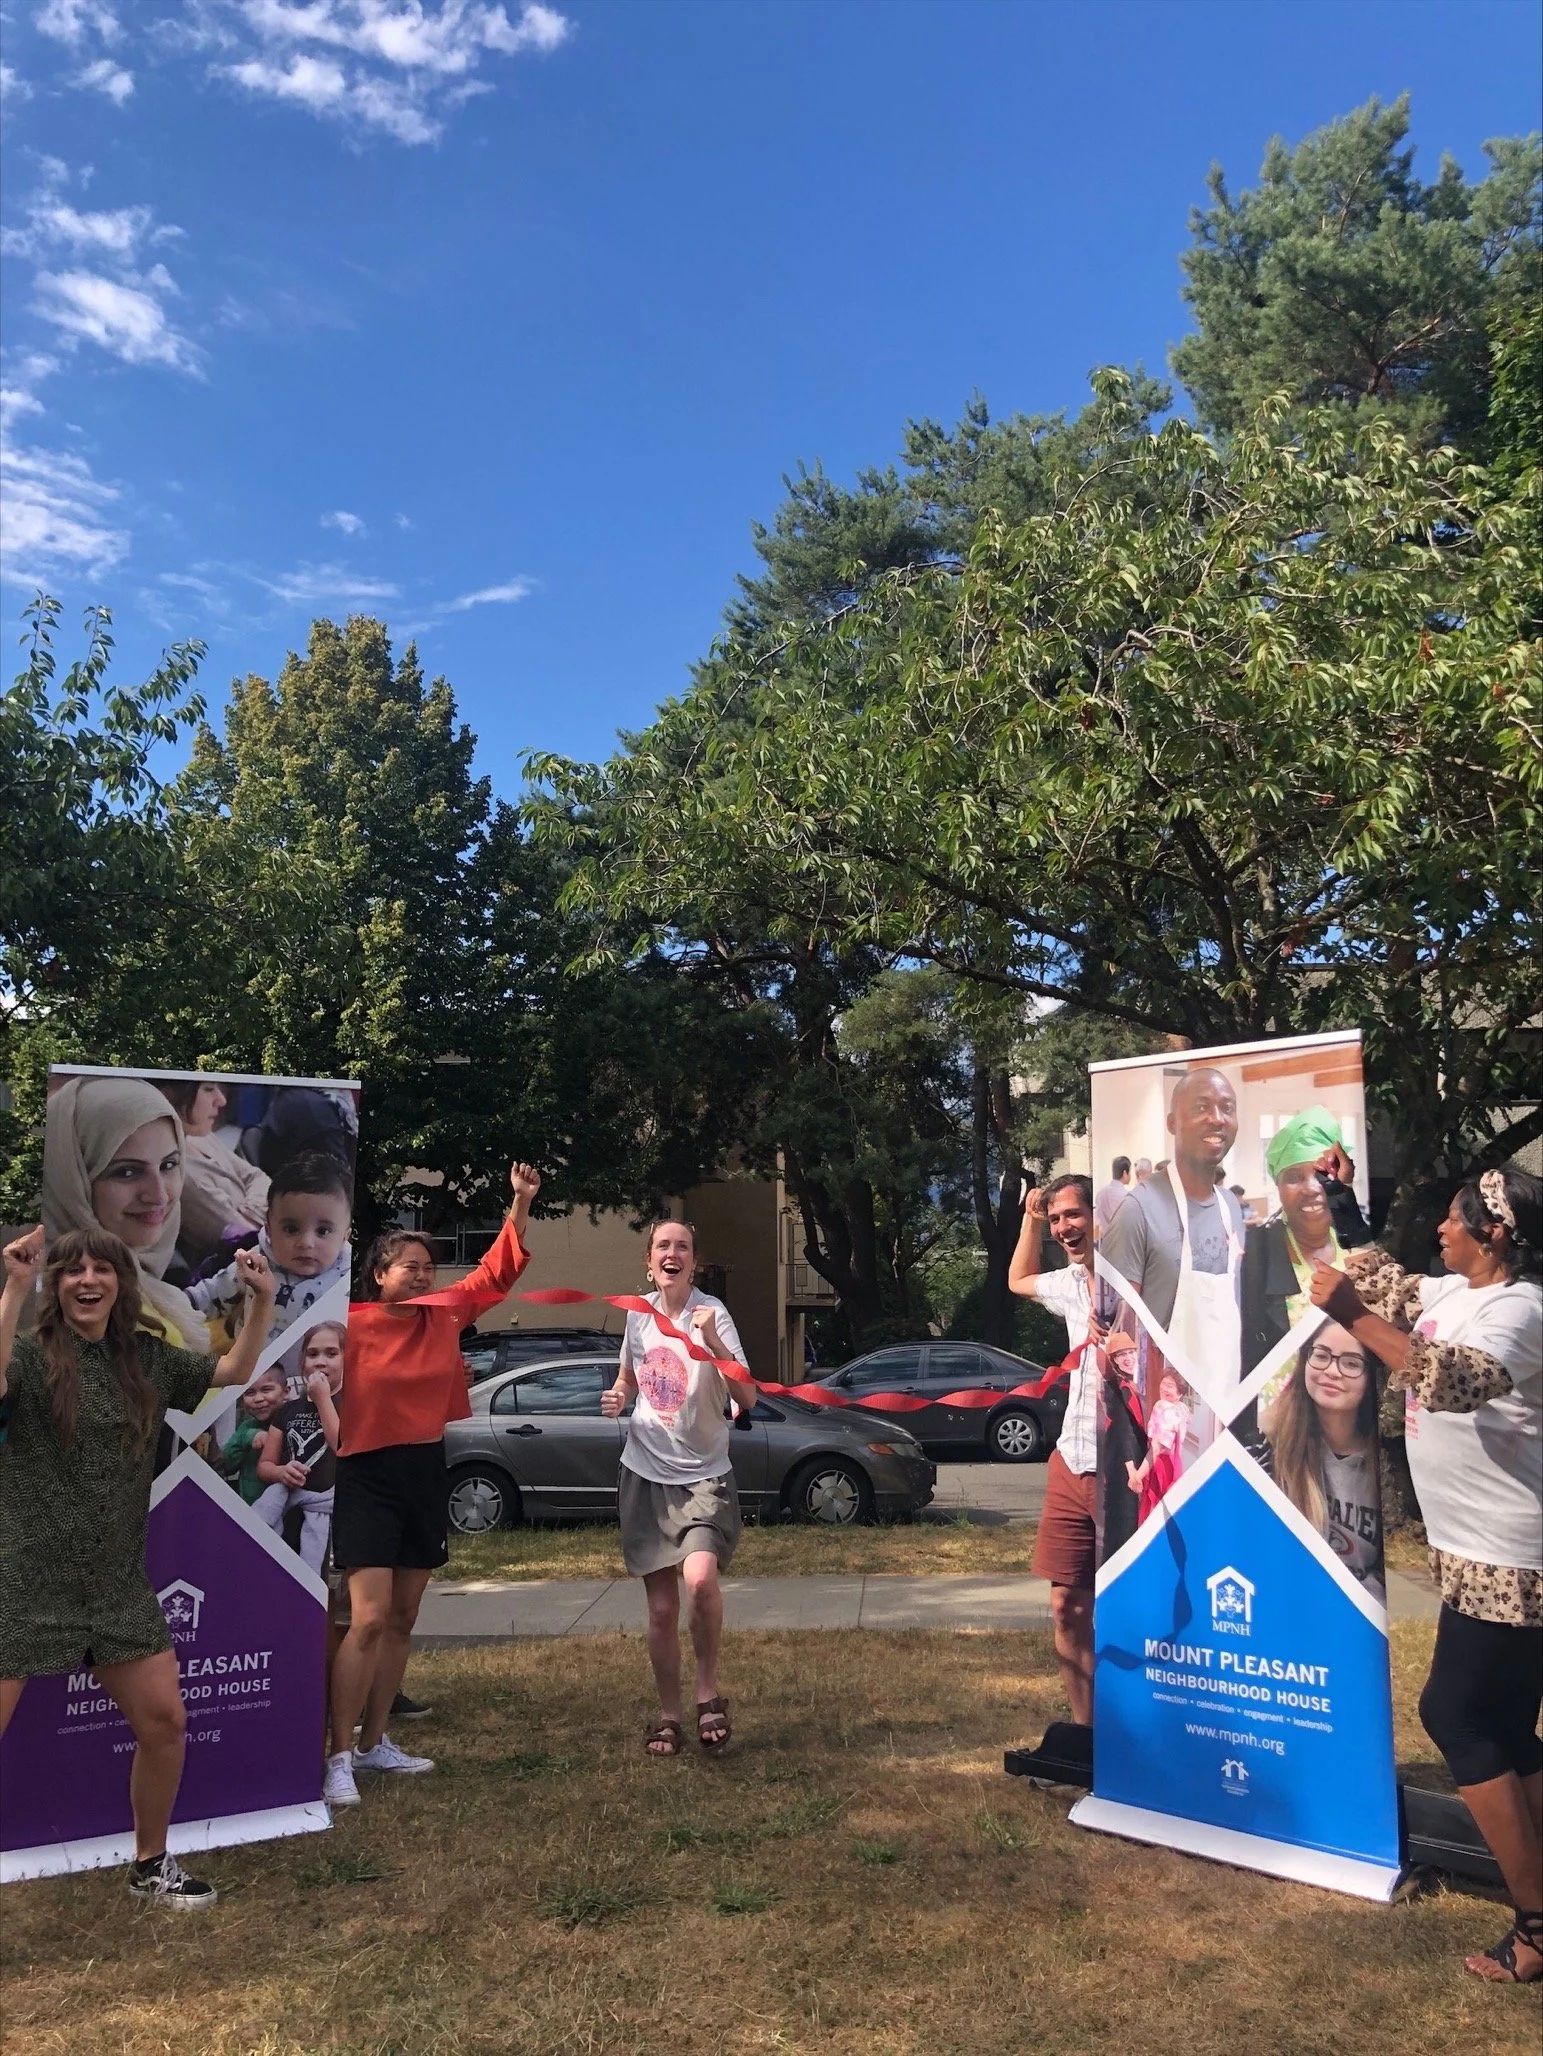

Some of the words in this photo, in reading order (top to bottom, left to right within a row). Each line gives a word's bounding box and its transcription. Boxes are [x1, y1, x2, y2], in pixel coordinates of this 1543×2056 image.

[1212, 1619, 1250, 1636] MPNH
[177, 1651, 273, 1679] LEASANT
[1145, 1638, 1214, 1668] MOUNT
[1220, 1651, 1329, 1687] PLEASANT
[218, 1678, 271, 1697] HOUSE
[1145, 1667, 1271, 1702] NEIGHBOURHOOD
[1277, 1690, 1332, 1713] HOUSE
[57, 1720, 107, 1735] connection
[227, 1699, 272, 1712] leadership
[1152, 1692, 1188, 1705] connection
[1196, 1700, 1235, 1714] celebration
[1293, 1717, 1334, 1734] leadership
[1185, 1722, 1285, 1756] www.mpnh.org
